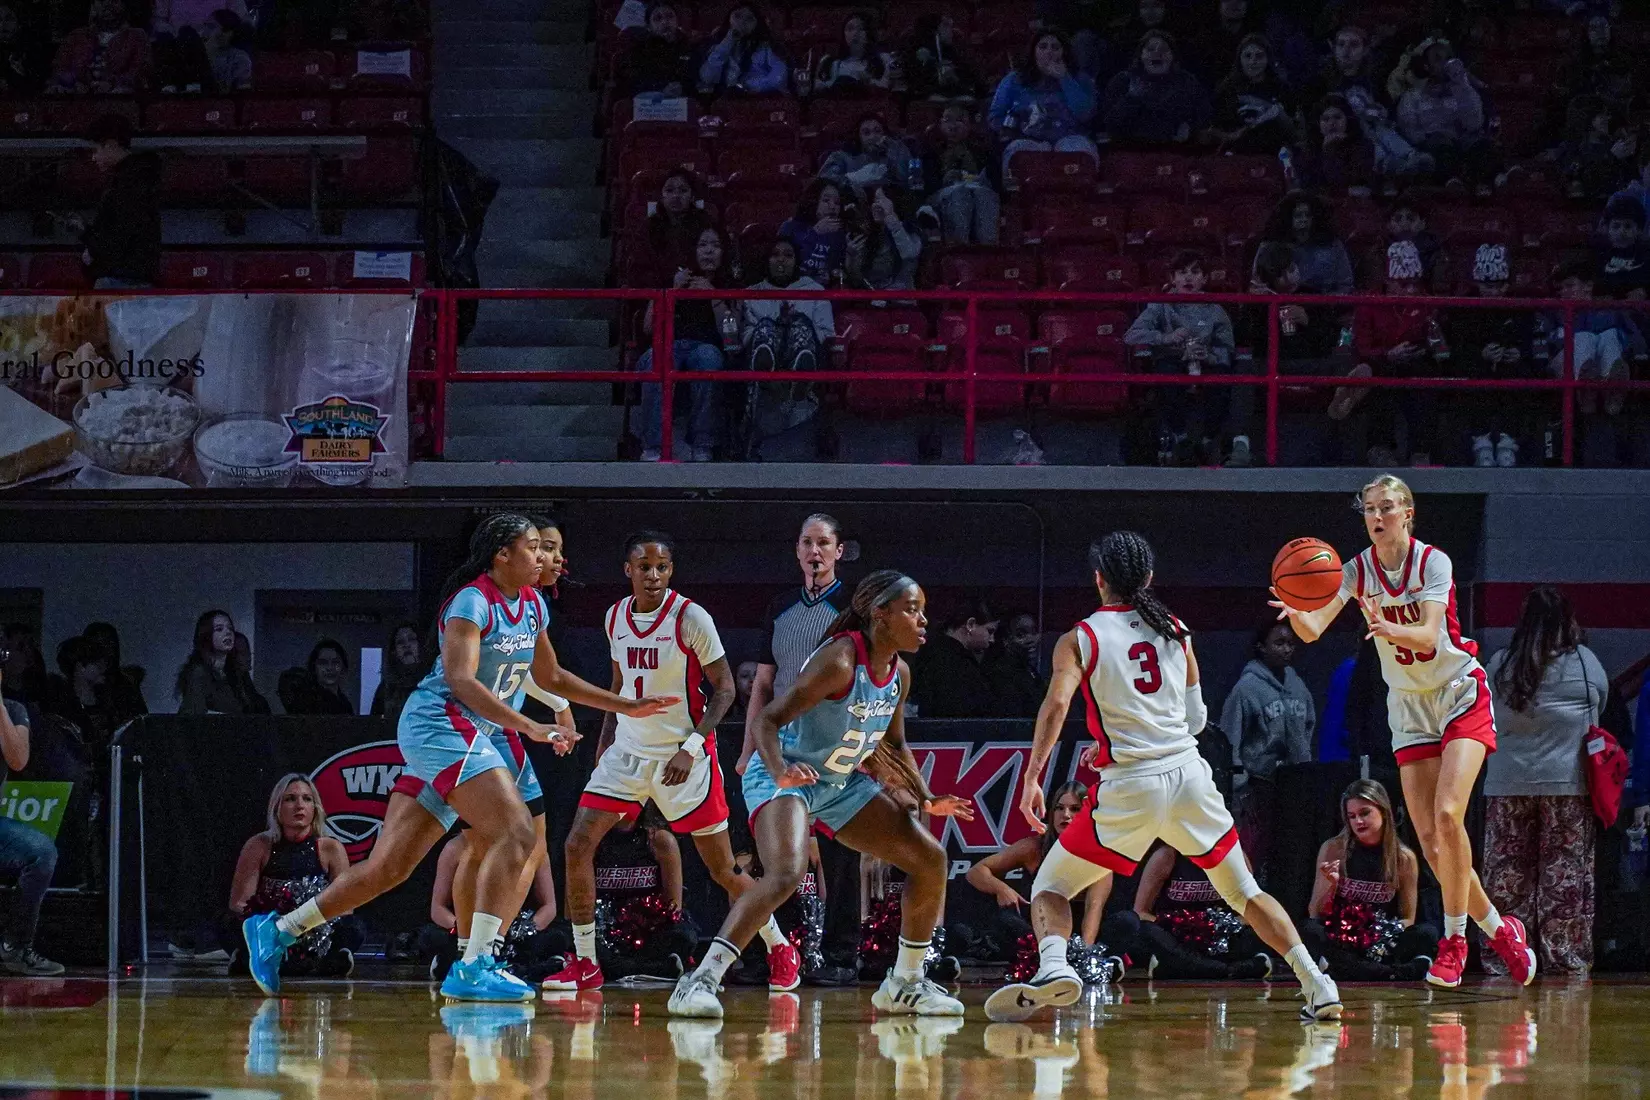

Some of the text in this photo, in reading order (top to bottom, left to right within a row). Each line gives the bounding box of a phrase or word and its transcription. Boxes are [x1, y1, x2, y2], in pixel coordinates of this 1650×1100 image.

[52, 350, 206, 380] Goodness
[298, 406, 376, 426] SOUTHLAND
[311, 449, 361, 458] FARMERS
[319, 440, 353, 450] DAIRY
[1381, 601, 1421, 625] WKU
[627, 646, 659, 670] WKU
[1128, 641, 1162, 695] 3
[491, 661, 532, 701] 15
[634, 675, 644, 700] 1
[341, 764, 403, 795] WK
[595, 877, 657, 889] KENTUCK
[597, 865, 658, 879] WESTERN
[1170, 880, 1216, 891] WESTE
